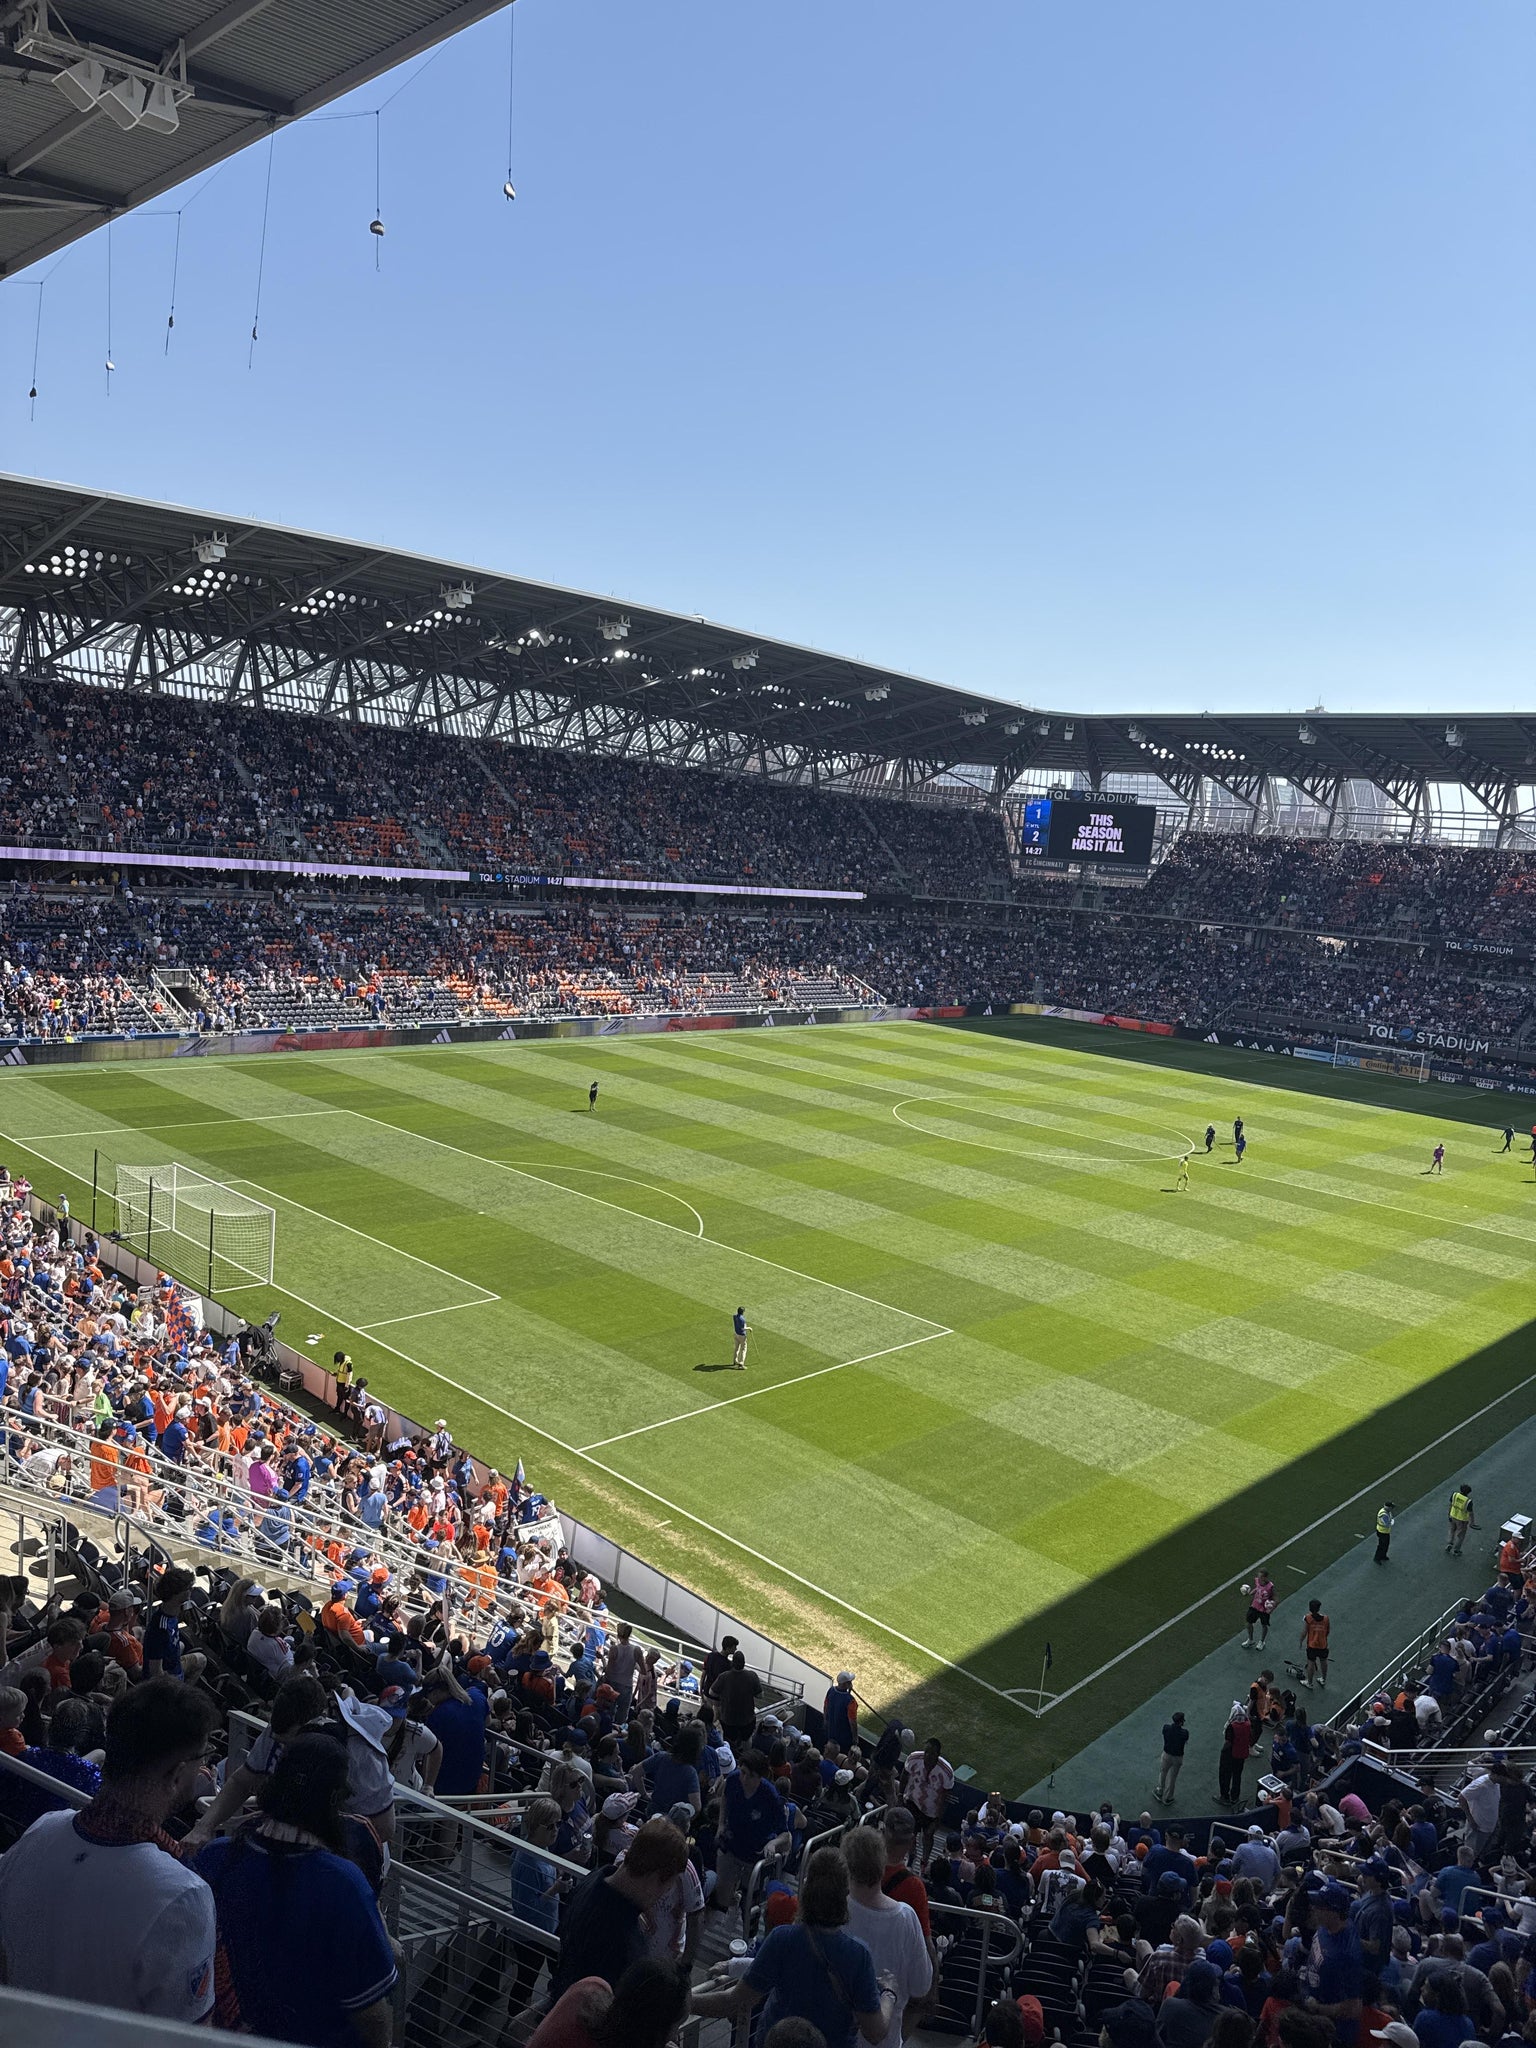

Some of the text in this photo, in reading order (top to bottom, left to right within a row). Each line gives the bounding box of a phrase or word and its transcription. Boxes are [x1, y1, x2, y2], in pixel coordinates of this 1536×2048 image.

[1048, 790, 1138, 804] TQL STADIUM
[1036, 808, 1041, 819] 1
[1090, 814, 1113, 826] THIS
[1032, 831, 1040, 842] 2
[1078, 826, 1122, 840] SEASON
[1025, 847, 1043, 855] 14:27
[1072, 839, 1124, 853] HAS IT ALL
[1033, 859, 1064, 868] CINCINNATI
[480, 873, 562, 885] TQL STADIUM 14:27
[1445, 941, 1514, 955] TQL STADIUM
[1367, 1023, 1490, 1054] TQL STADIUM
[1517, 1085, 1536, 1095] MER
